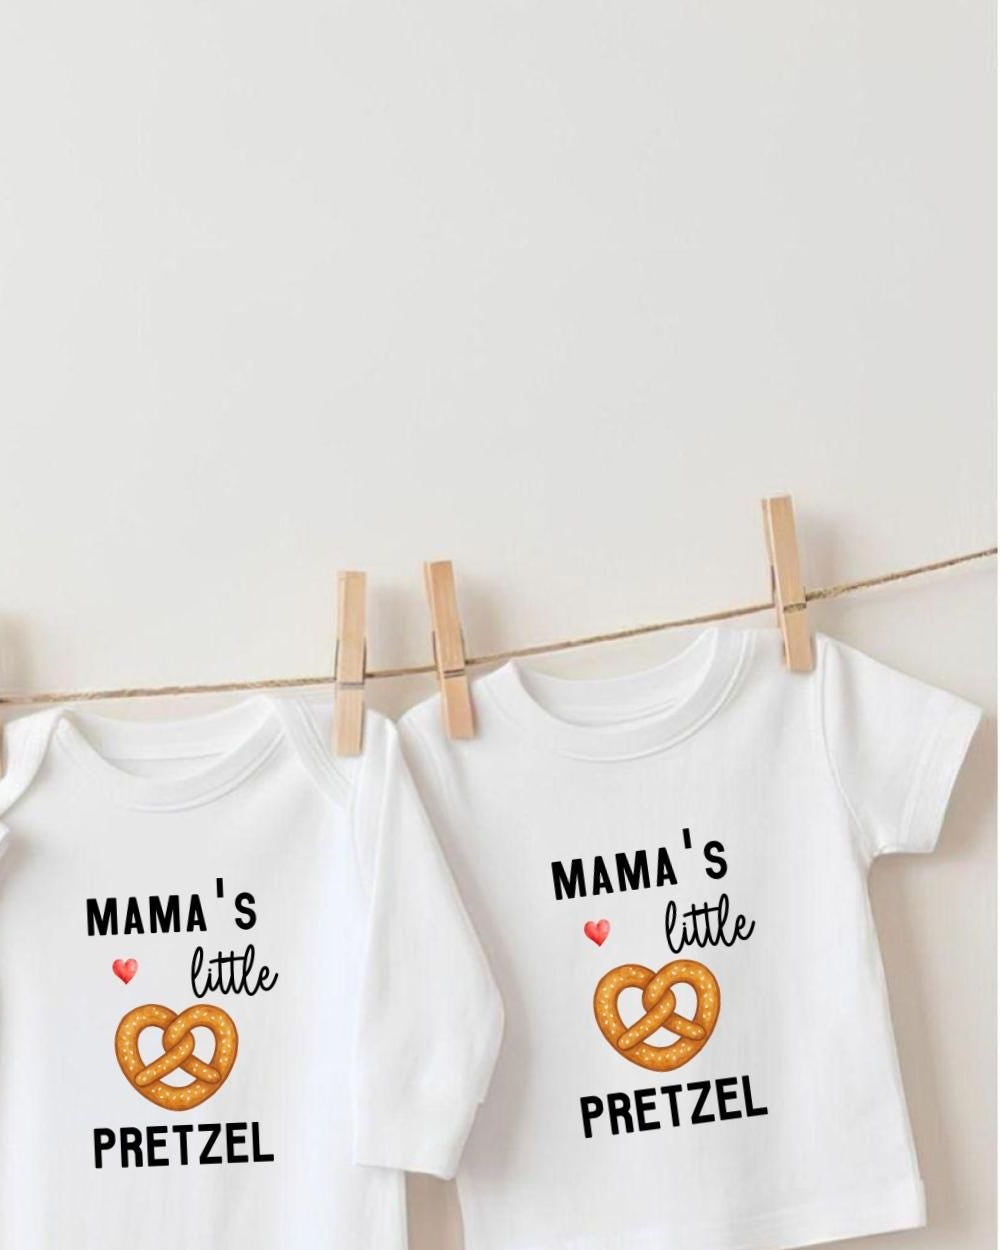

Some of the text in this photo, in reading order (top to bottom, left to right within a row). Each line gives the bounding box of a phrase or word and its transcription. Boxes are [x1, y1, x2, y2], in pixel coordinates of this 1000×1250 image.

[551, 828, 727, 900] MAMA'S
[87, 878, 256, 936] MAMA'S
[665, 893, 755, 954] little
[191, 944, 278, 998] little
[580, 1075, 768, 1138] PRETZEL
[94, 1122, 274, 1168] PRETZEL
